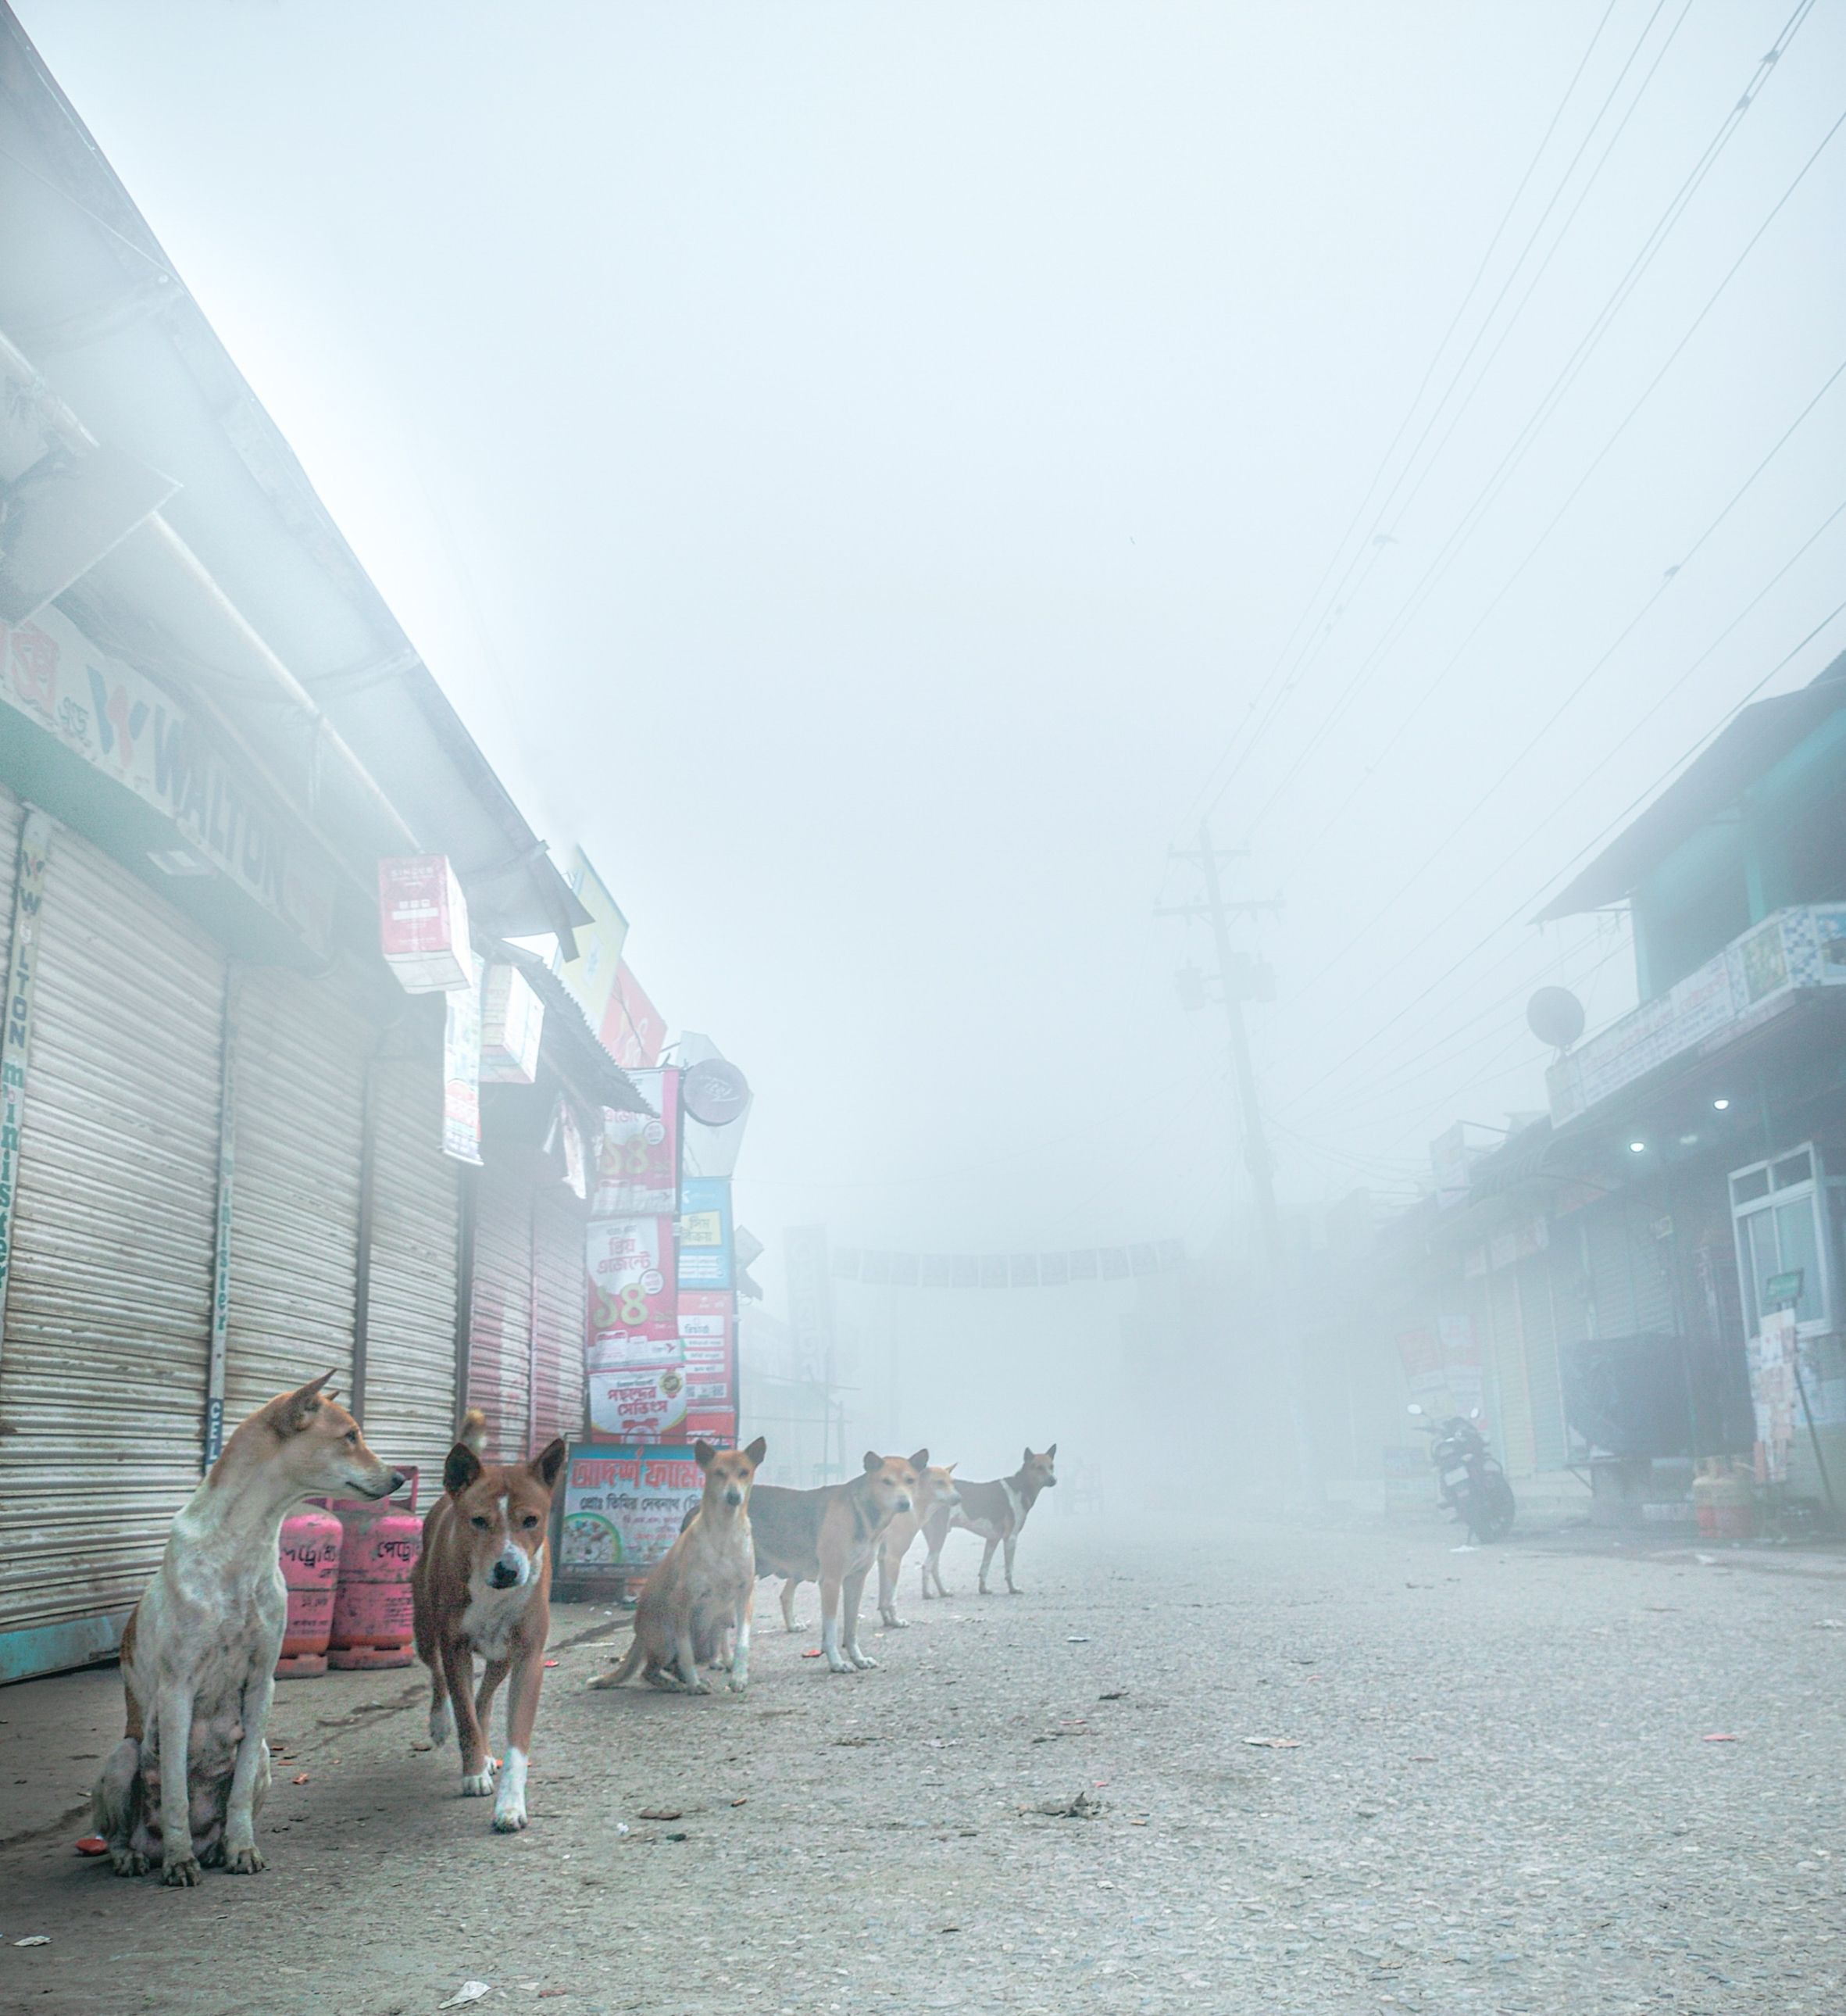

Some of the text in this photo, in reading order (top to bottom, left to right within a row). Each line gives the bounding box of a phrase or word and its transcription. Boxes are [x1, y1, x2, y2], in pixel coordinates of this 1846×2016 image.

[9, 885, 42, 1048] WLTON
[592, 1283, 648, 1328] ১৪
[570, 1446, 644, 1489] আদর্শ
